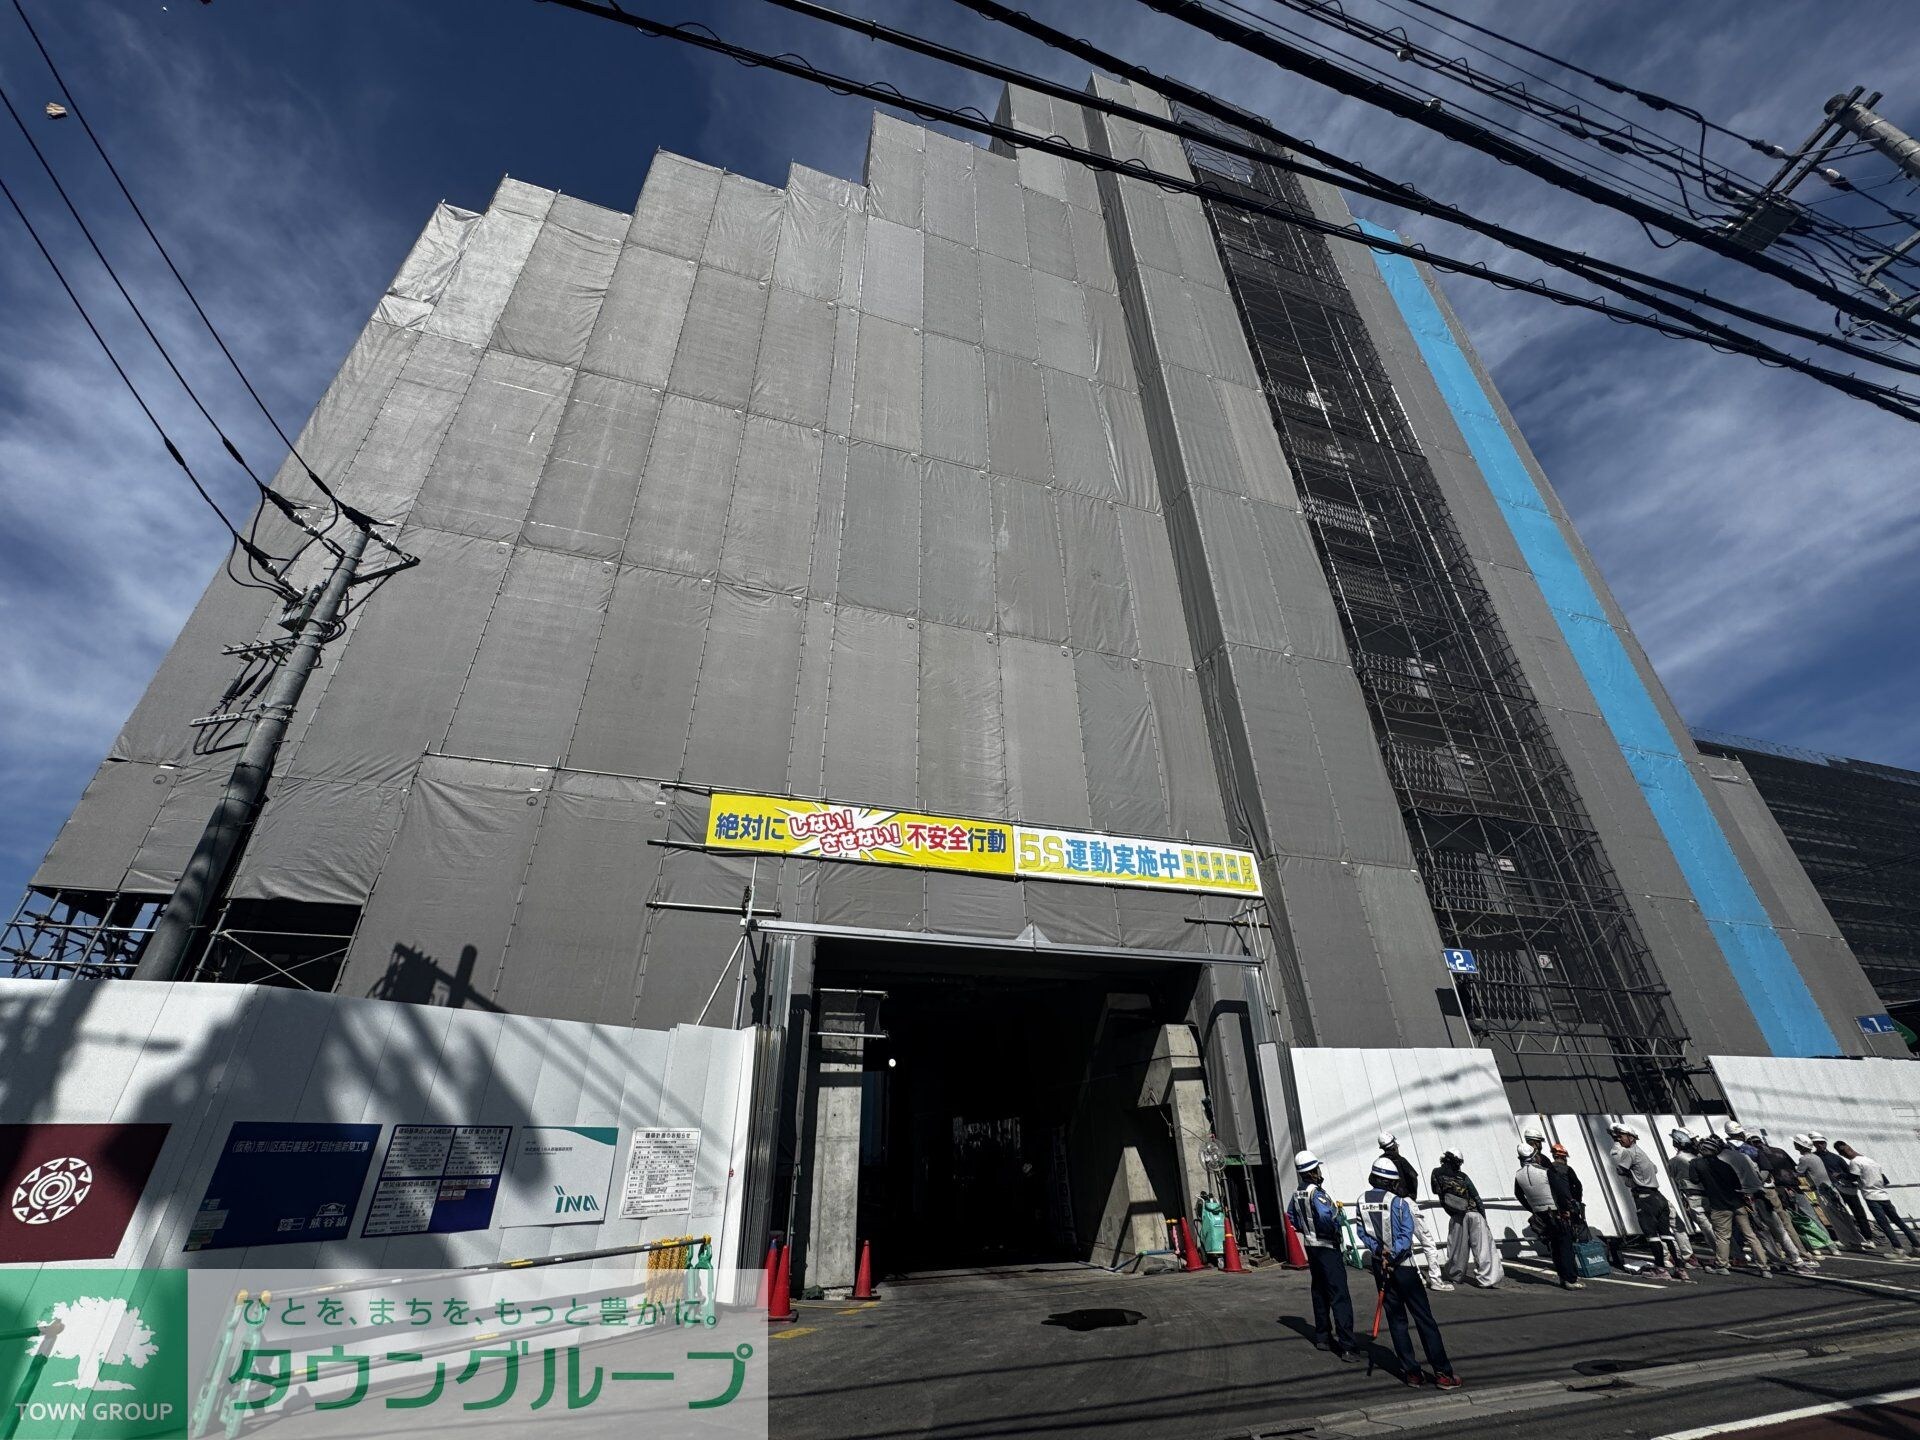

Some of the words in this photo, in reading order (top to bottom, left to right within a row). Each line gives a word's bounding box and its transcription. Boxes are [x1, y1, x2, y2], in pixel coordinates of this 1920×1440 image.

[715, 812, 785, 840] 絶対に
[906, 823, 1006, 853] 不安全行動
[1019, 832, 1181, 879] 5S運動実施中
